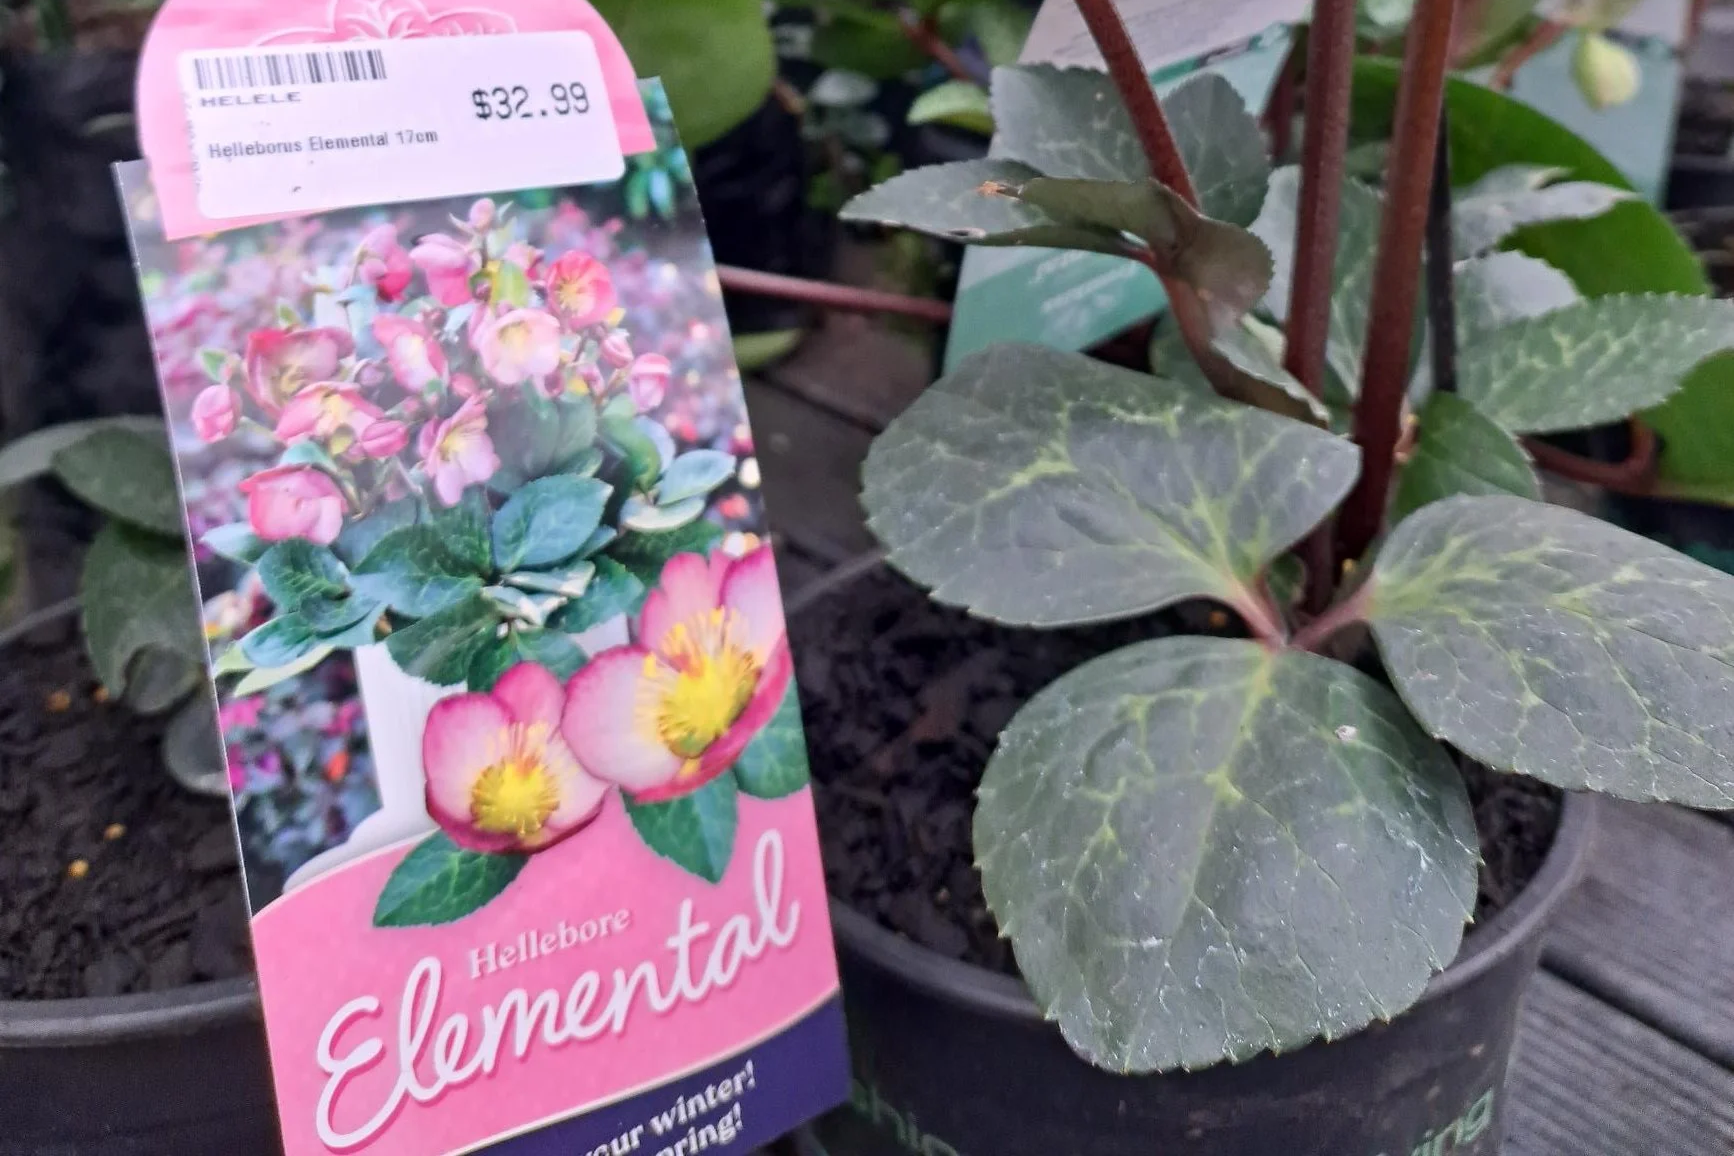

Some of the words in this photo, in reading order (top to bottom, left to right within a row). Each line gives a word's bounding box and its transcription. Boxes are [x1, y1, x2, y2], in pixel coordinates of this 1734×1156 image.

[200, 91, 303, 108] HELELE
[471, 81, 590, 121] $32.99
[308, 131, 389, 152] Elemental
[395, 128, 439, 146] 17cm
[468, 907, 632, 981] Hellebore
[315, 828, 800, 1150] Elemental
[649, 1058, 757, 1136] winter!
